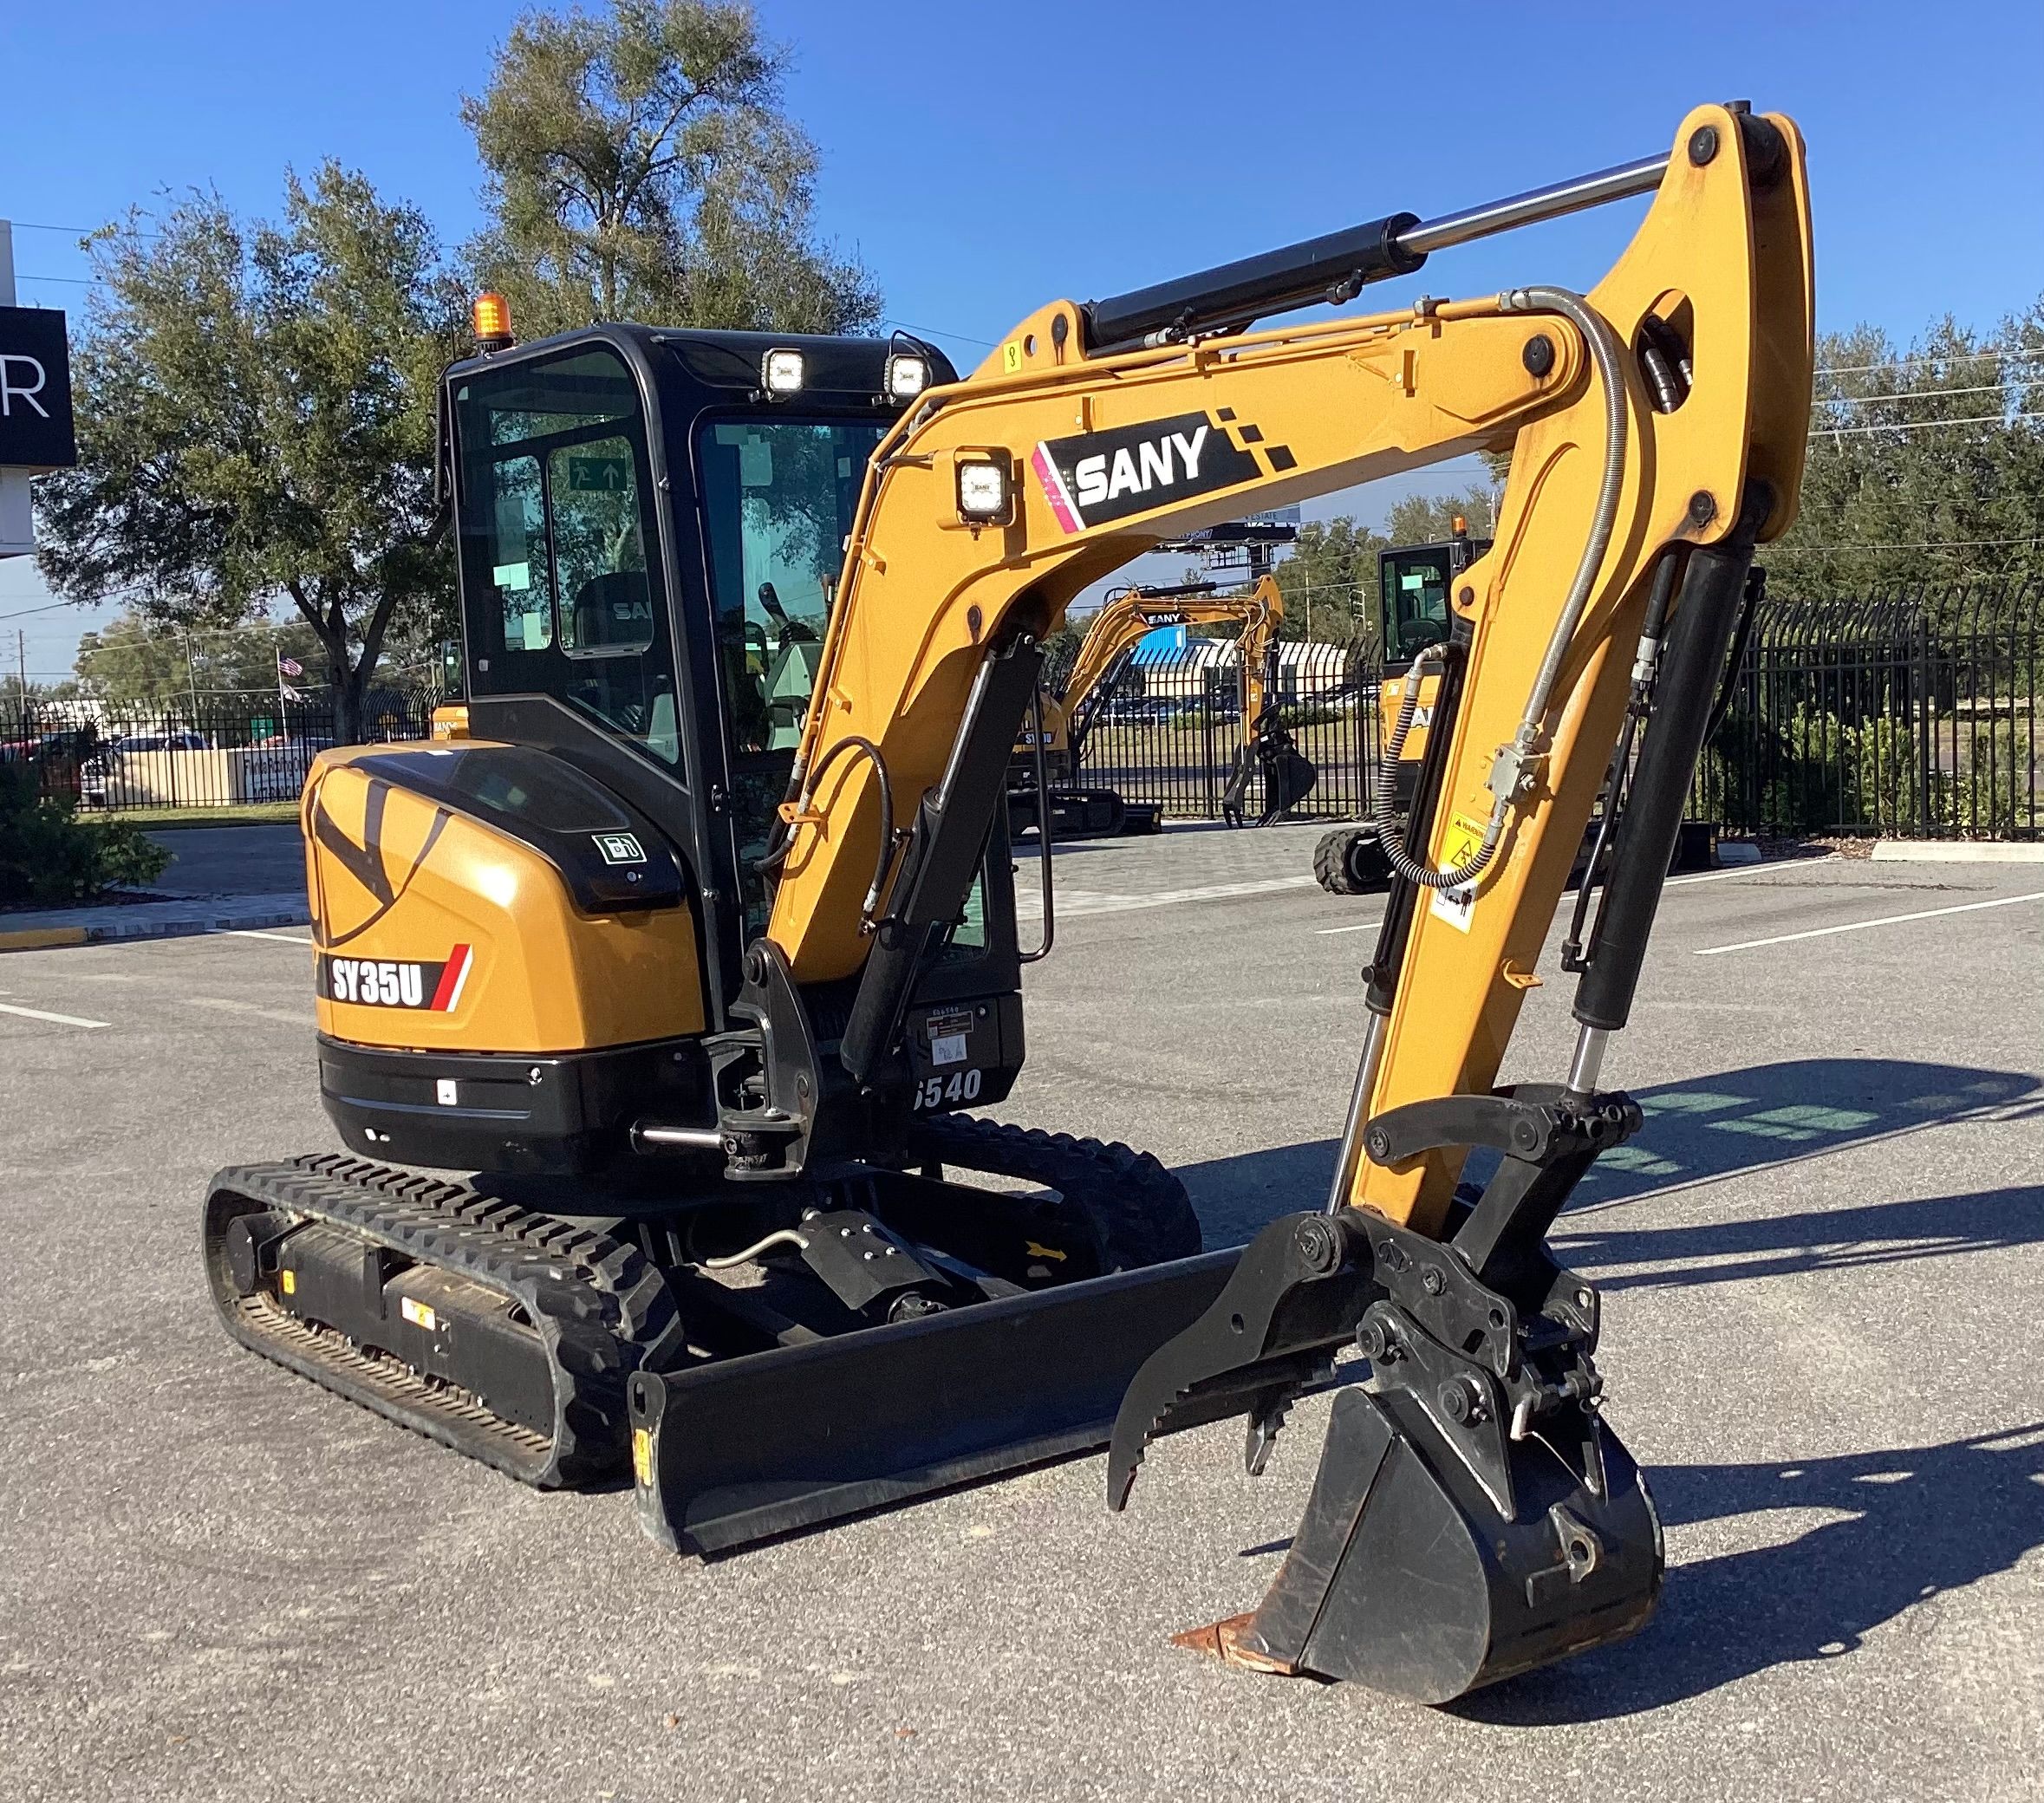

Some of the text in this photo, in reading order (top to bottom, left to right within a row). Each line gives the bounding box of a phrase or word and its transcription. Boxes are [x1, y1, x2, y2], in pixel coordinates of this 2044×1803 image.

[1076, 425, 1208, 507] SANY
[1250, 511, 1278, 521] ESTATE
[1148, 613, 1180, 624] SANY
[332, 959, 424, 1007] SY35U
